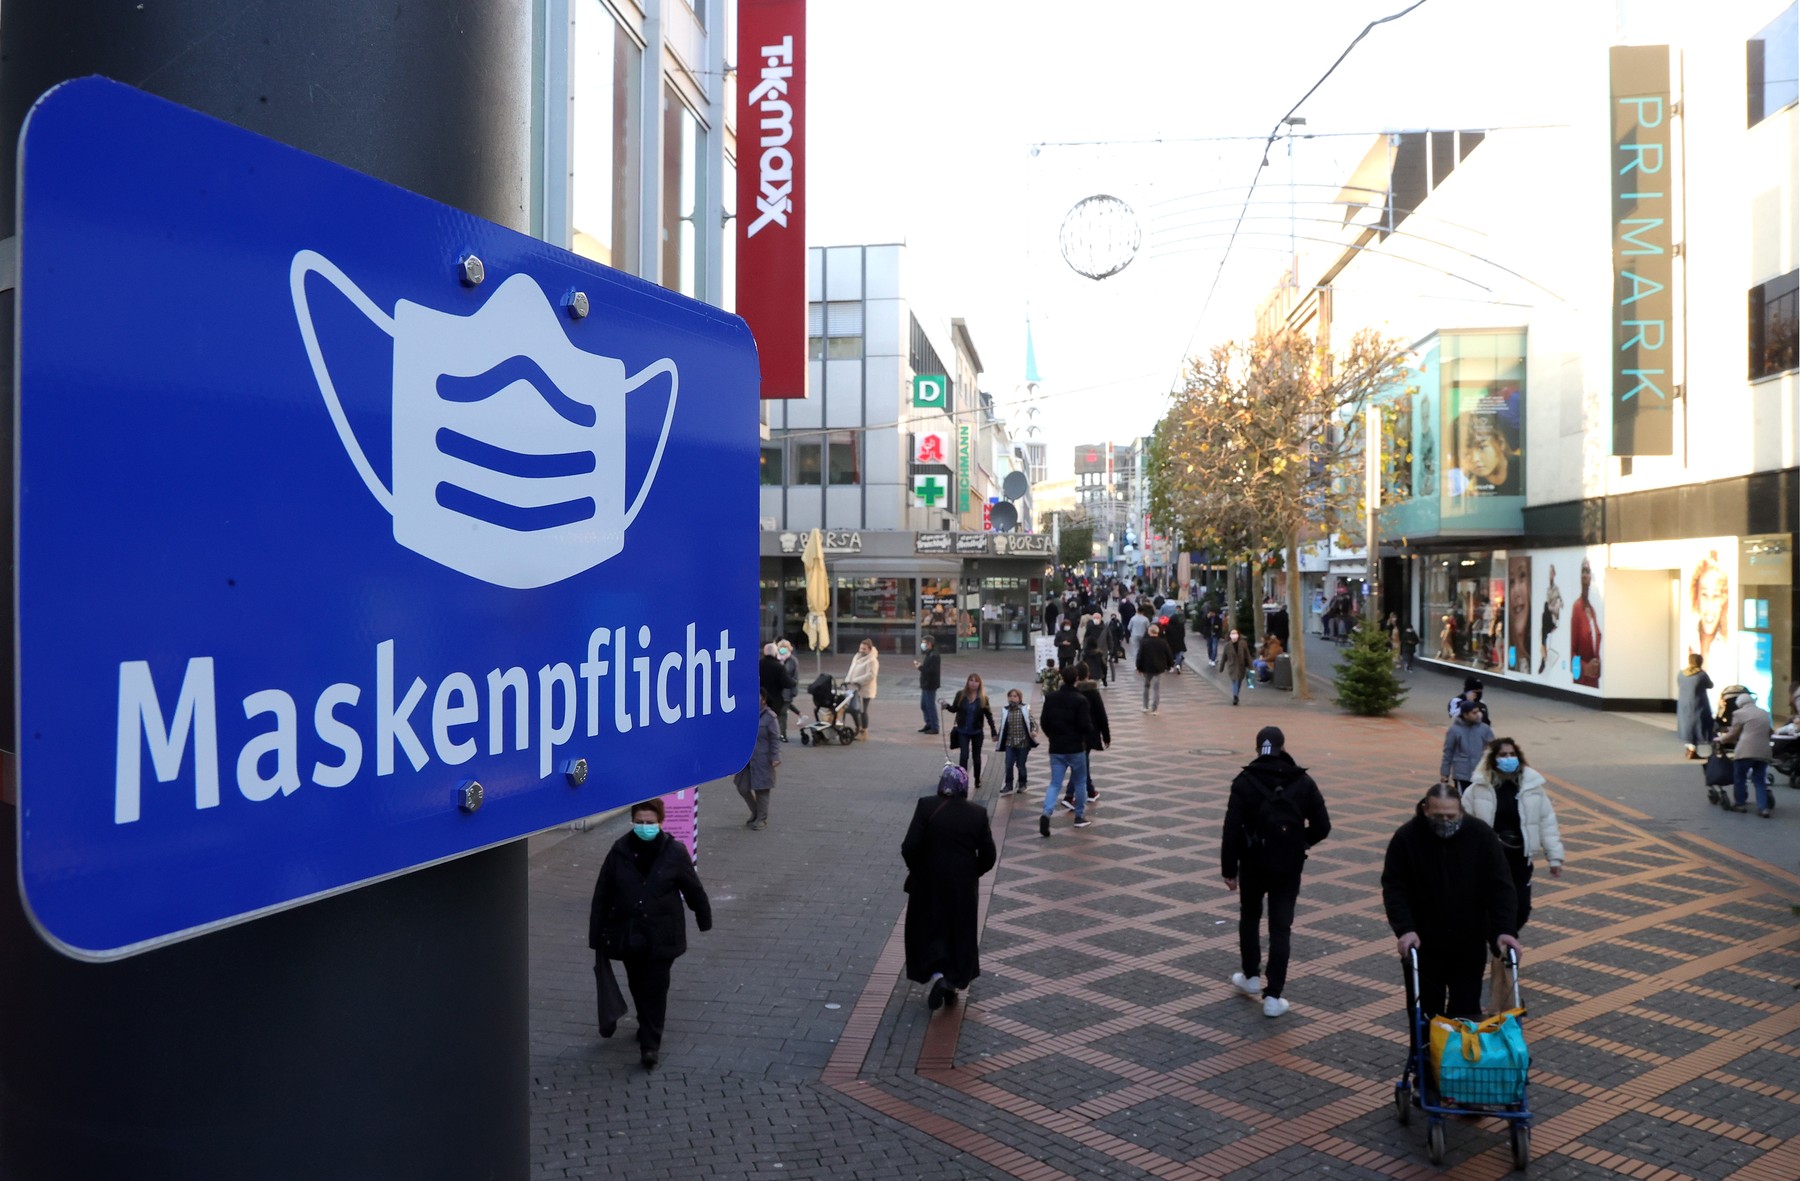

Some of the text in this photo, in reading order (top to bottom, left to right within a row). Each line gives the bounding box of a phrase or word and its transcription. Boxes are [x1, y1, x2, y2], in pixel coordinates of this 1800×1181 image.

[1619, 96, 1665, 402] PRIMARK
[918, 380, 941, 402] D
[960, 426, 970, 512] DEICHMANN
[800, 532, 862, 548] BRSA
[1009, 535, 1053, 551] BORSA
[114, 621, 737, 825] Maskenpflicht
